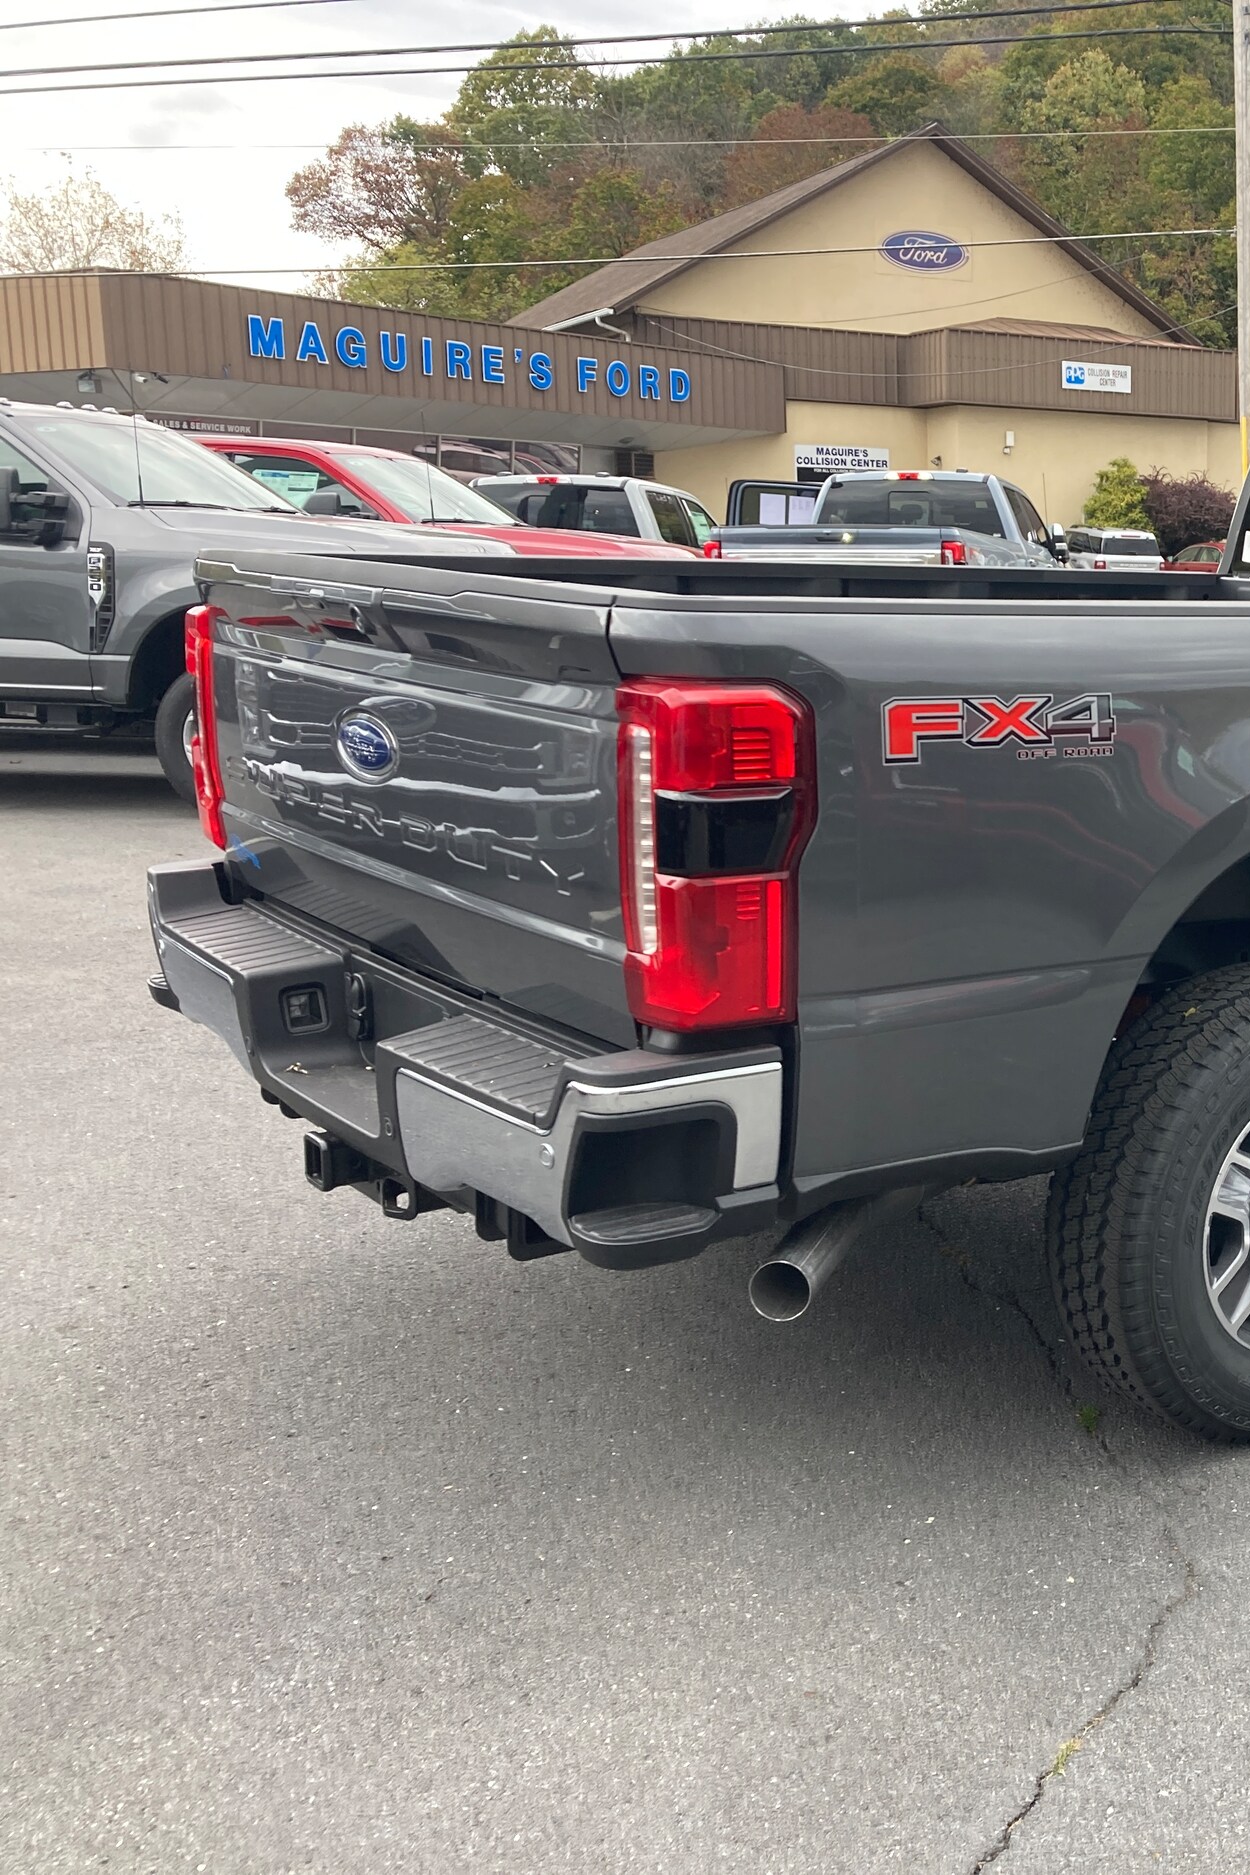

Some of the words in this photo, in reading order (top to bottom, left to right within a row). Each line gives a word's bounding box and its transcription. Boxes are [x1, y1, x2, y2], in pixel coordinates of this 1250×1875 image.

[900, 236, 948, 264] Ford
[247, 314, 553, 391] MAGUIRE'S
[576, 356, 692, 402] FORD
[1066, 367, 1085, 382] PPG
[1087, 368, 1110, 377] COLLISION
[1112, 369, 1128, 379] REPAIR
[1099, 378, 1117, 386] CENTER
[182, 421, 188, 429] &
[190, 421, 225, 432] SERVICE
[227, 424, 252, 434] WORK
[816, 447, 869, 458] MAGUIRE'S
[796, 456, 847, 467] COLLISION
[851, 458, 888, 468] CENTER
[881, 692, 1116, 766] FX4
[1017, 748, 1057, 761] OFF
[1063, 746, 1114, 759] ROAD
[225, 756, 385, 838] SUPER
[400, 814, 585, 897] DUTY
